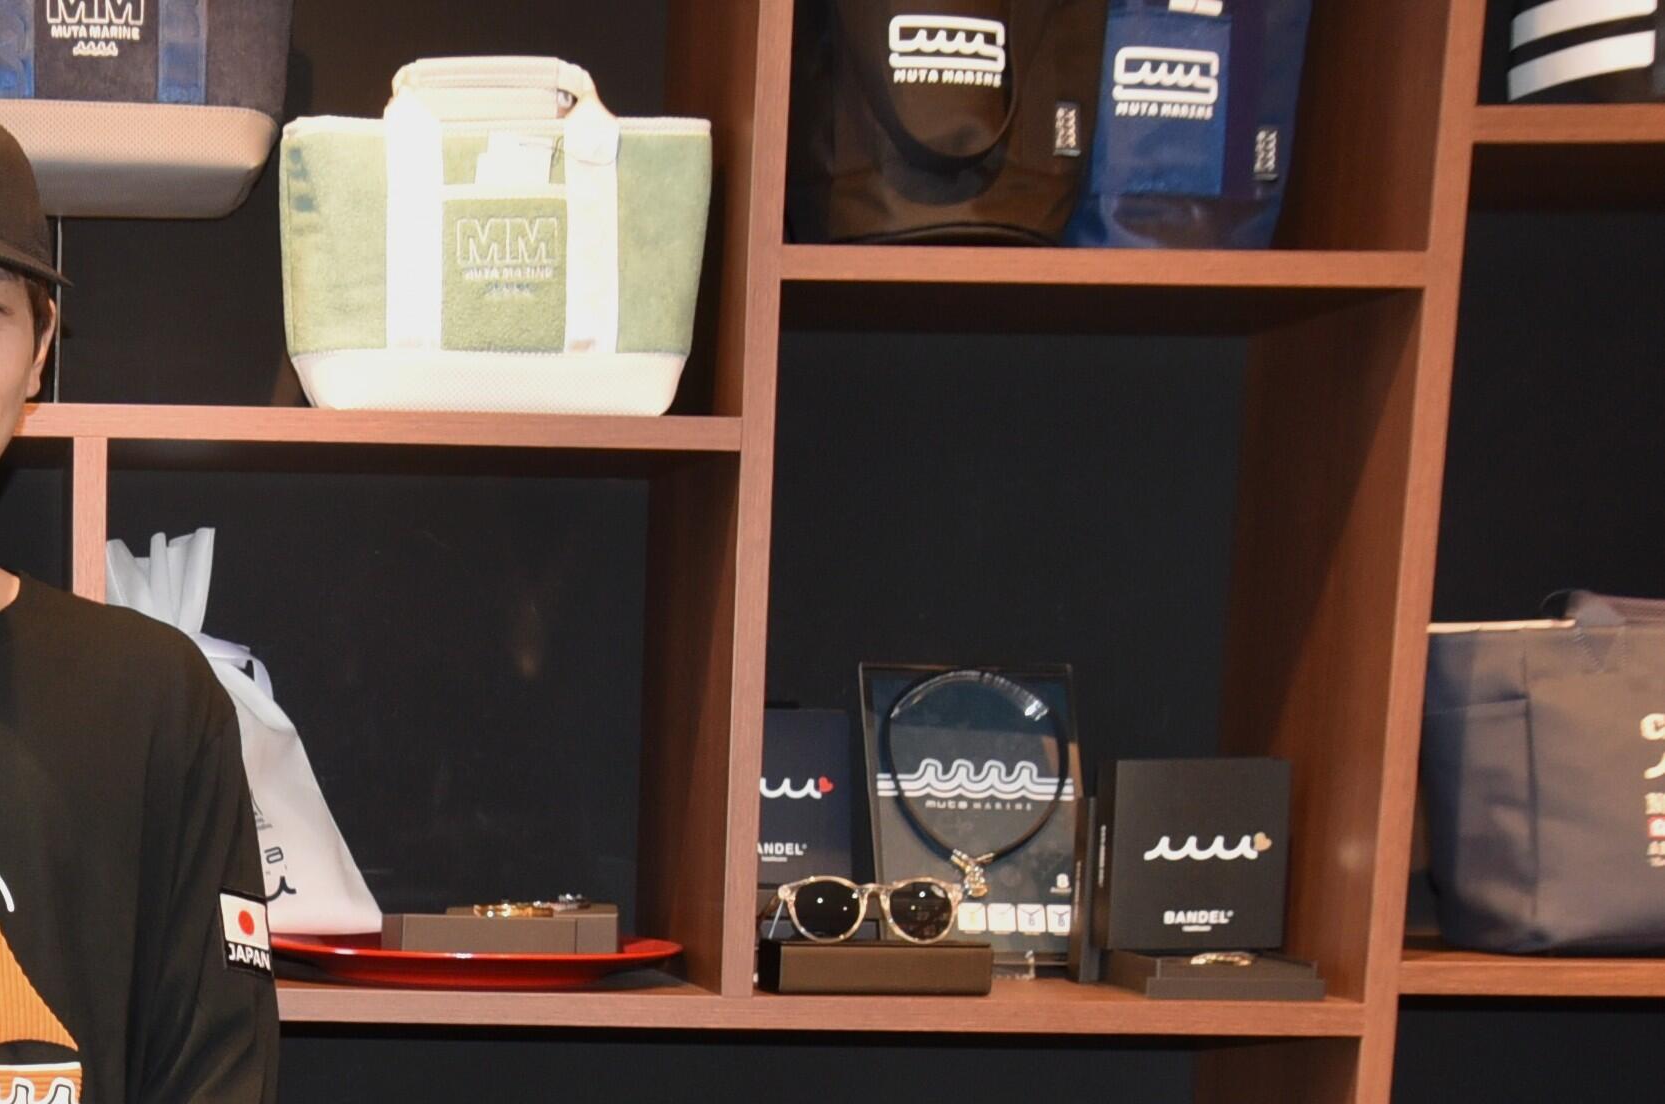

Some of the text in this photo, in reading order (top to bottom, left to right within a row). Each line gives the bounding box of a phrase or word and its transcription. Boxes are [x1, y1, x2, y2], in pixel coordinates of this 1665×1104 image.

[51, 25, 140, 40] MUTA MARINE
[893, 69, 1002, 88] MUTA MARINE
[1115, 102, 1213, 120] MUTA MARINE
[456, 217, 558, 265] MM
[757, 842, 804, 855] ANDEL
[228, 943, 271, 970] JAPAN
